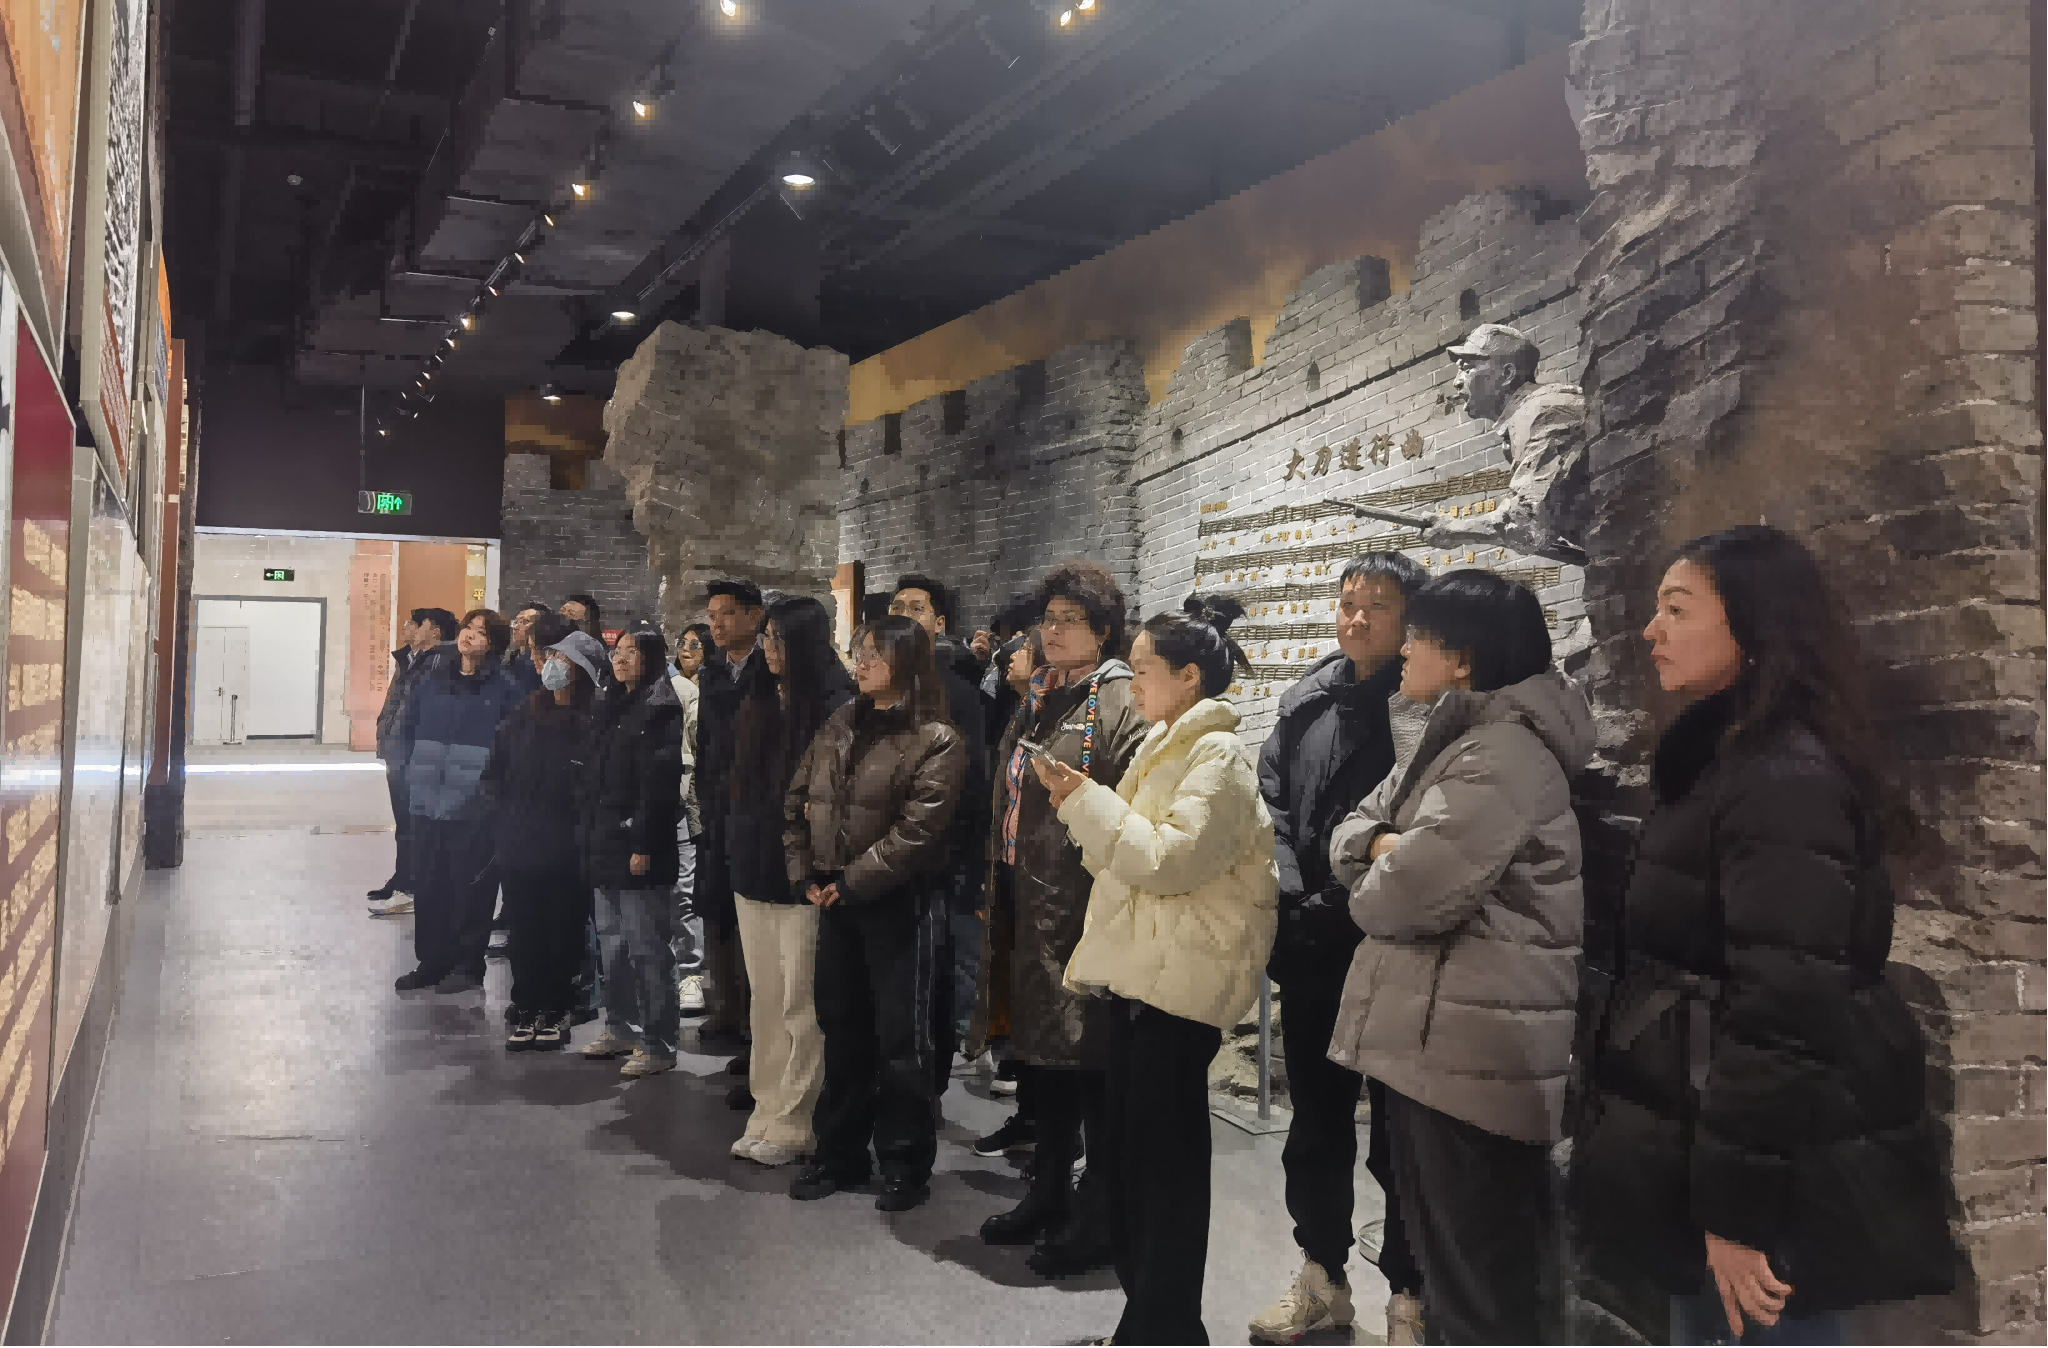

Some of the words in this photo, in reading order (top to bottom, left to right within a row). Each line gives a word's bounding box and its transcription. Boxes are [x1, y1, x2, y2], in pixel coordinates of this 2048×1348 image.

[1282, 428, 1425, 481] 大刀进行曲
[1087, 694, 1096, 721] LOVE
[1084, 722, 1093, 748] LOVE
